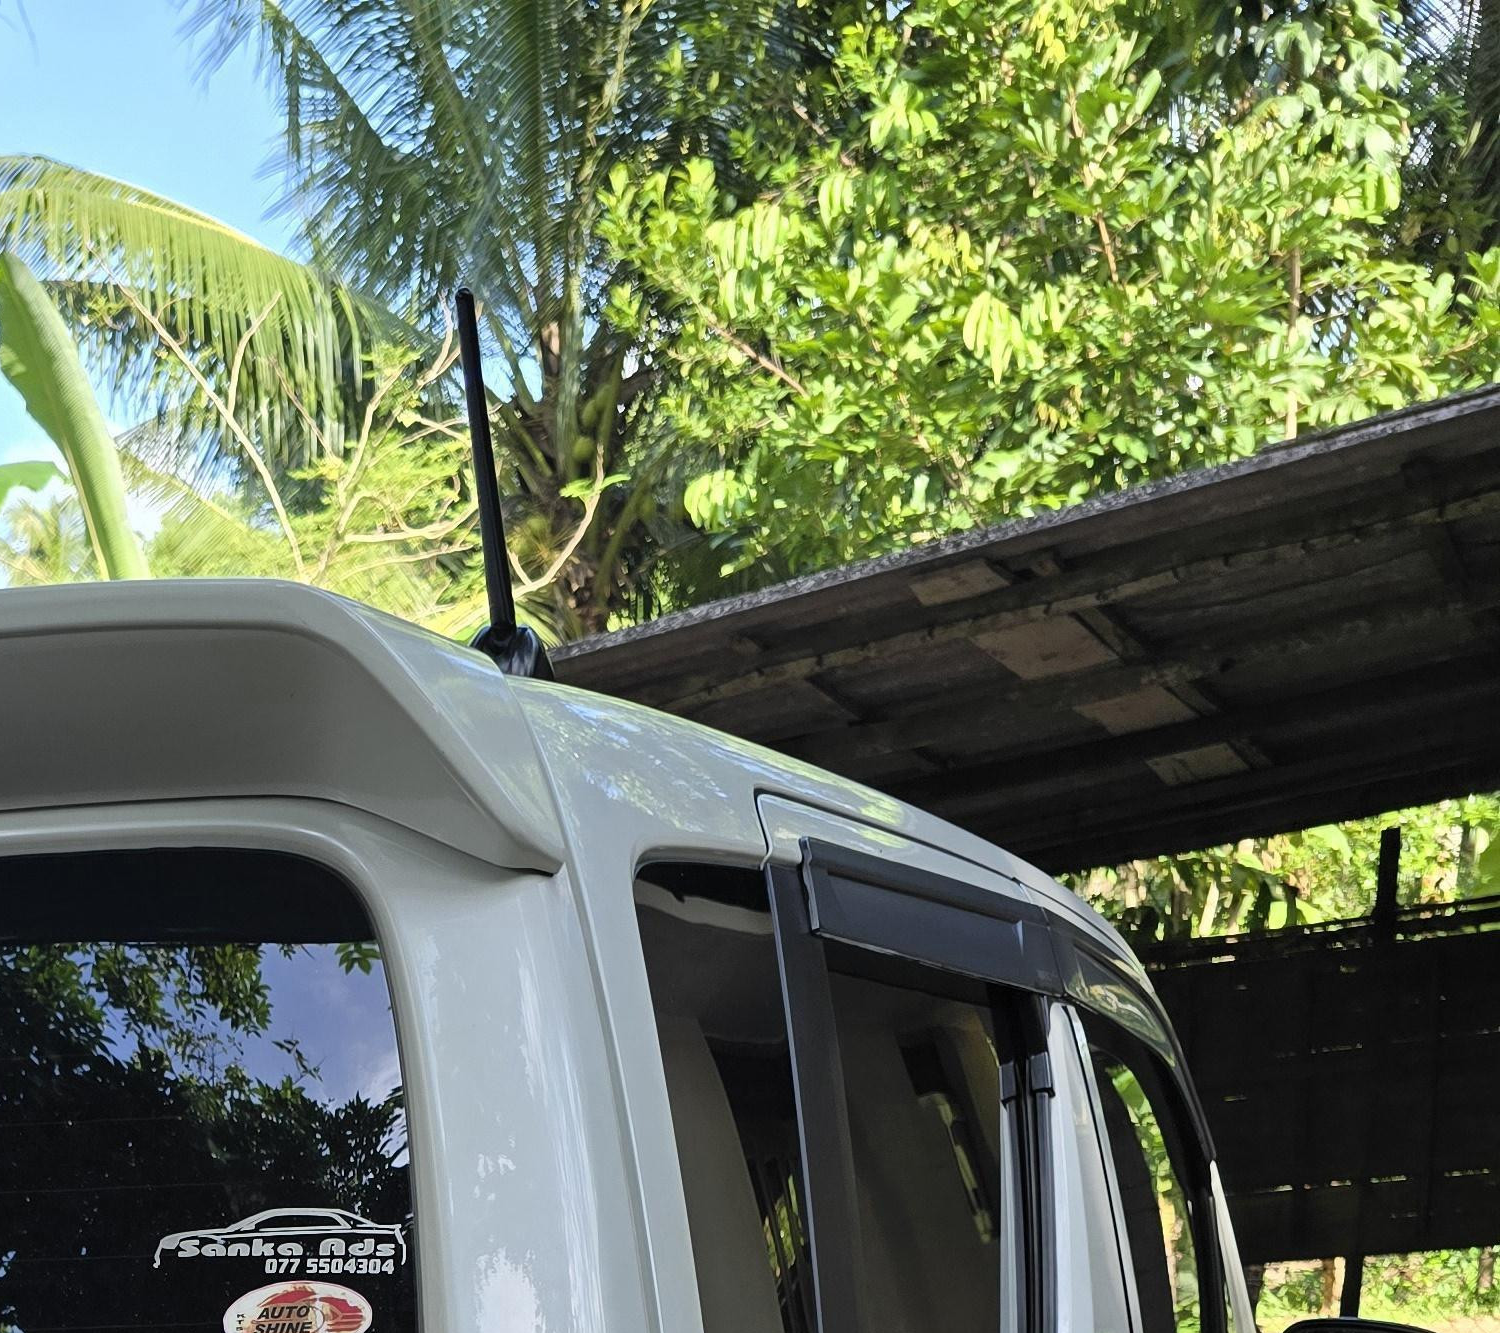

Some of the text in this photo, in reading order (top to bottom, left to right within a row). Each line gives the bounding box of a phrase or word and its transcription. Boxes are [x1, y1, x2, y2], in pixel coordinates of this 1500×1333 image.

[178, 1237, 396, 1258] Sanka Ads
[264, 1258, 395, 1275] 077 5504304
[257, 1305, 311, 1320] AUTO
